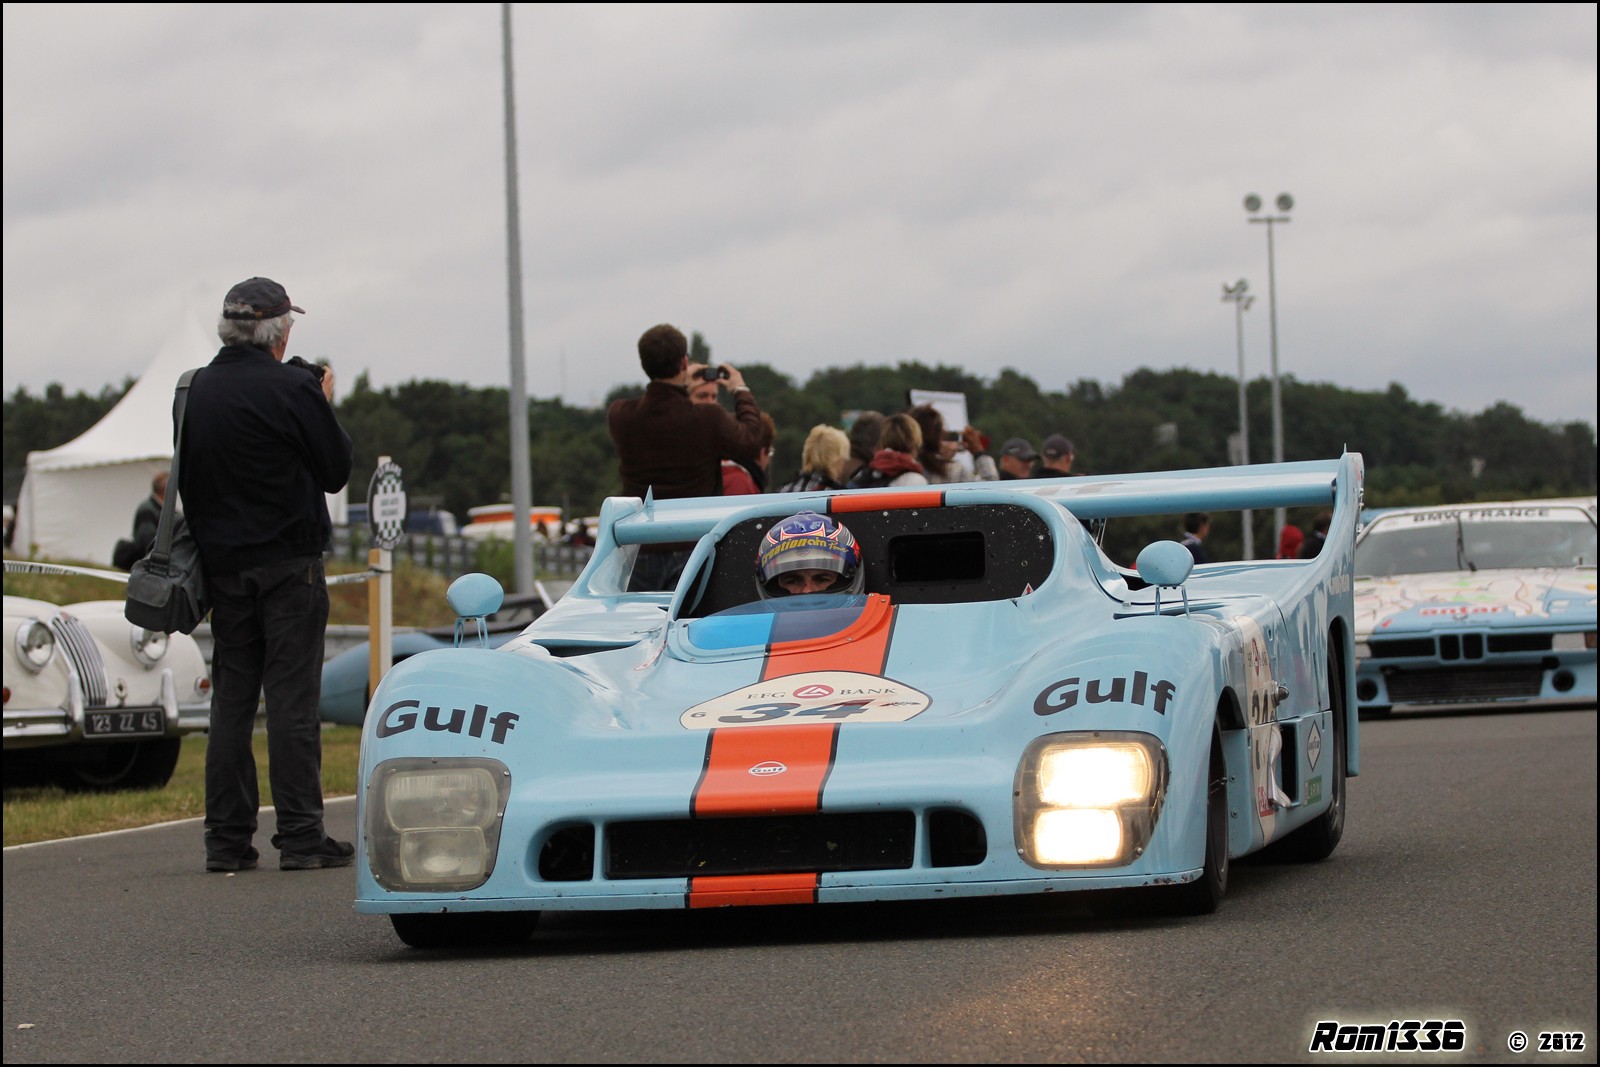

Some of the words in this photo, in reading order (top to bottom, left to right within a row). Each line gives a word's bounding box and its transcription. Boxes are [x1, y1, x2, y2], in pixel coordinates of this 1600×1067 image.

[1413, 512, 1460, 523] BMW
[1468, 508, 1550, 519] FRANCE
[747, 691, 786, 700] EFG
[840, 687, 898, 696] BANK
[1033, 671, 1176, 716] Gulf
[376, 700, 520, 745] Gulf
[718, 699, 876, 724] 34
